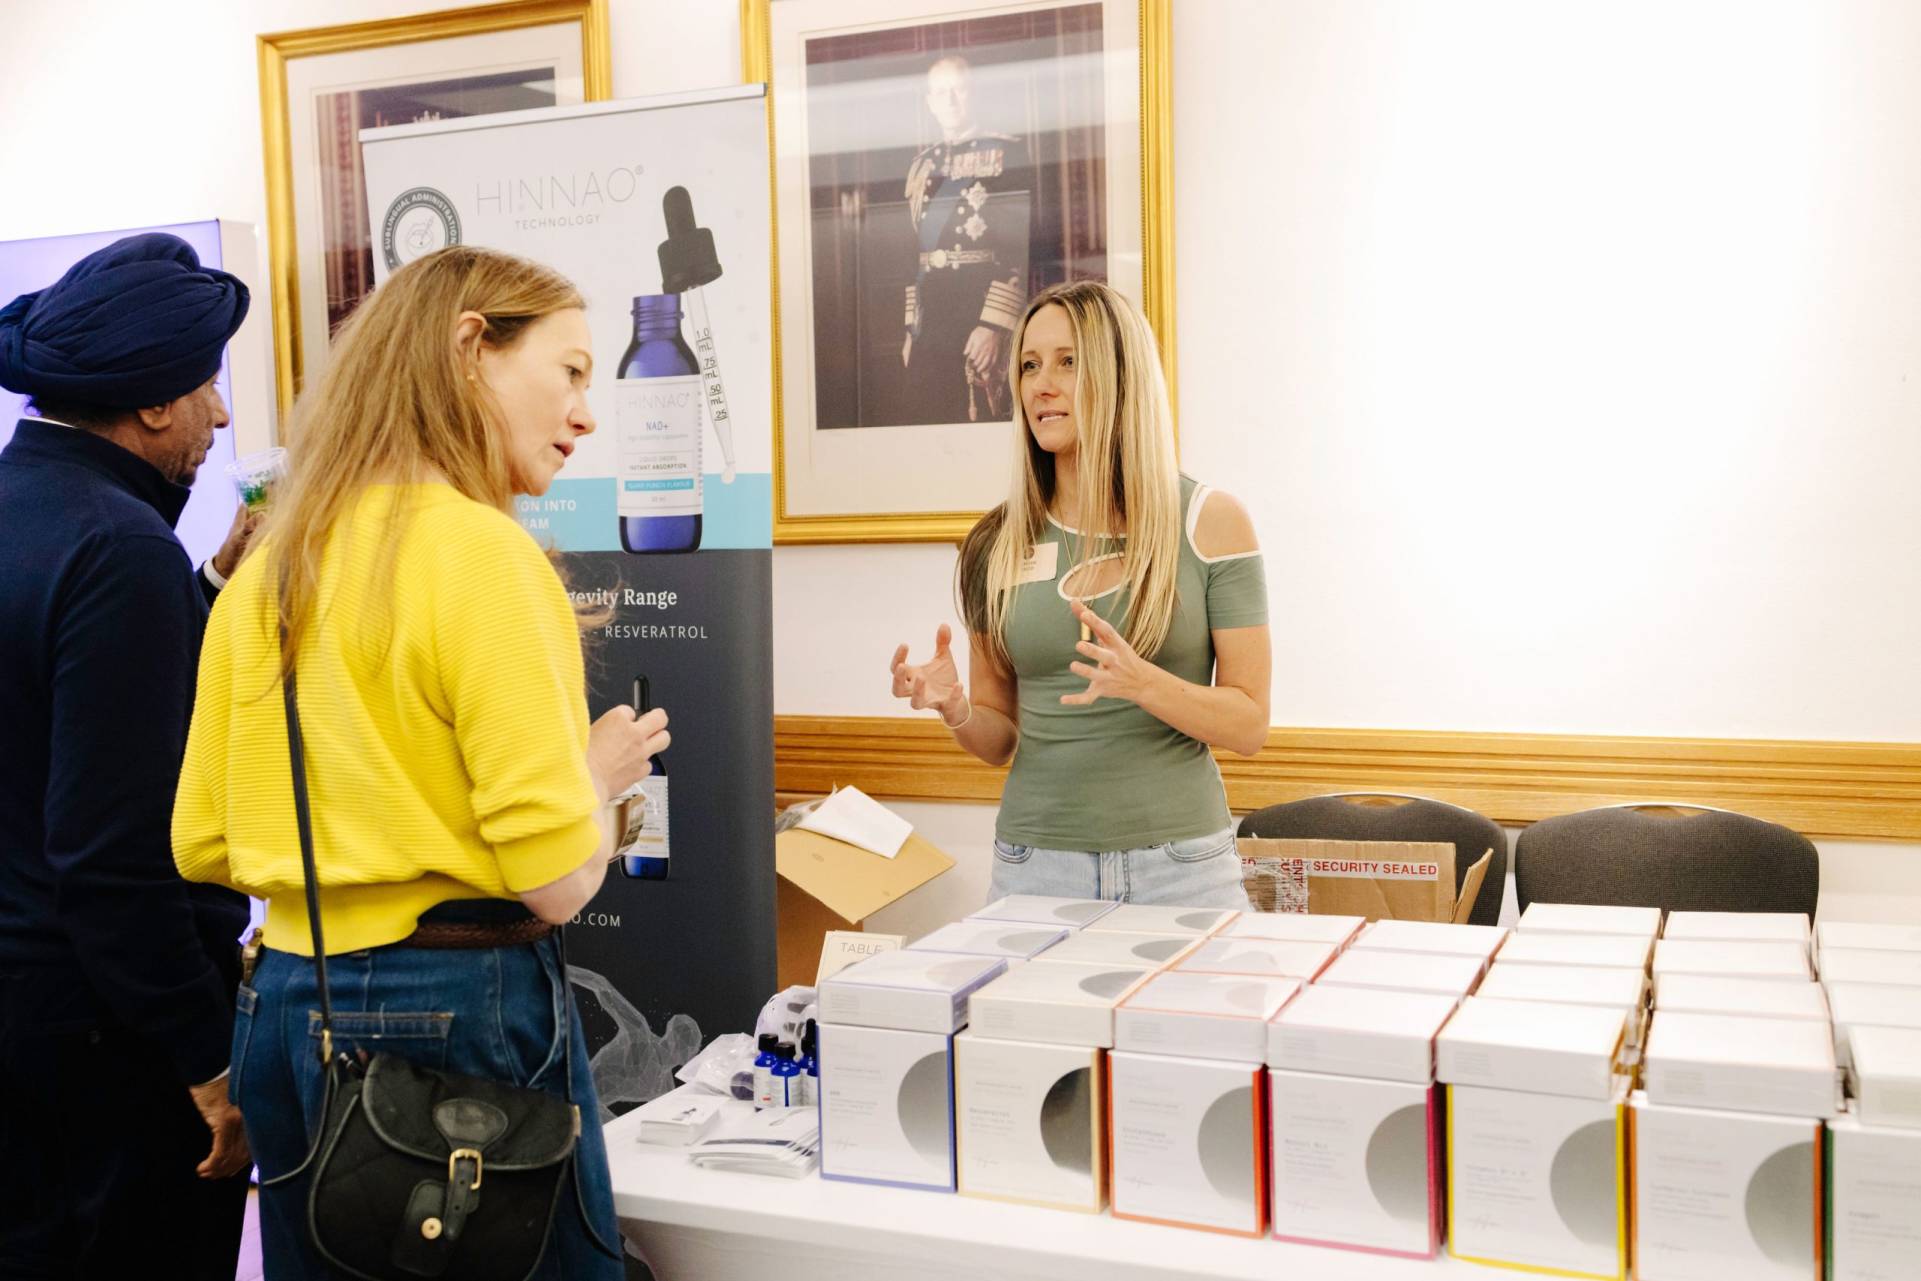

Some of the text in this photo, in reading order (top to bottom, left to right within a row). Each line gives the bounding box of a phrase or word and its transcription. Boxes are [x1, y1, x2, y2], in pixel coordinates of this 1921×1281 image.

[384, 198, 411, 251] SUBLINGUAL
[515, 214, 600, 231] TECHNOLOGY
[646, 420, 669, 431] NAD+
[520, 499, 577, 512] ON INTO
[523, 517, 550, 529] EAM
[567, 588, 678, 610] gevity Range
[605, 625, 708, 639] RESVERATROL
[1313, 861, 1437, 875] SECURITY SEALED
